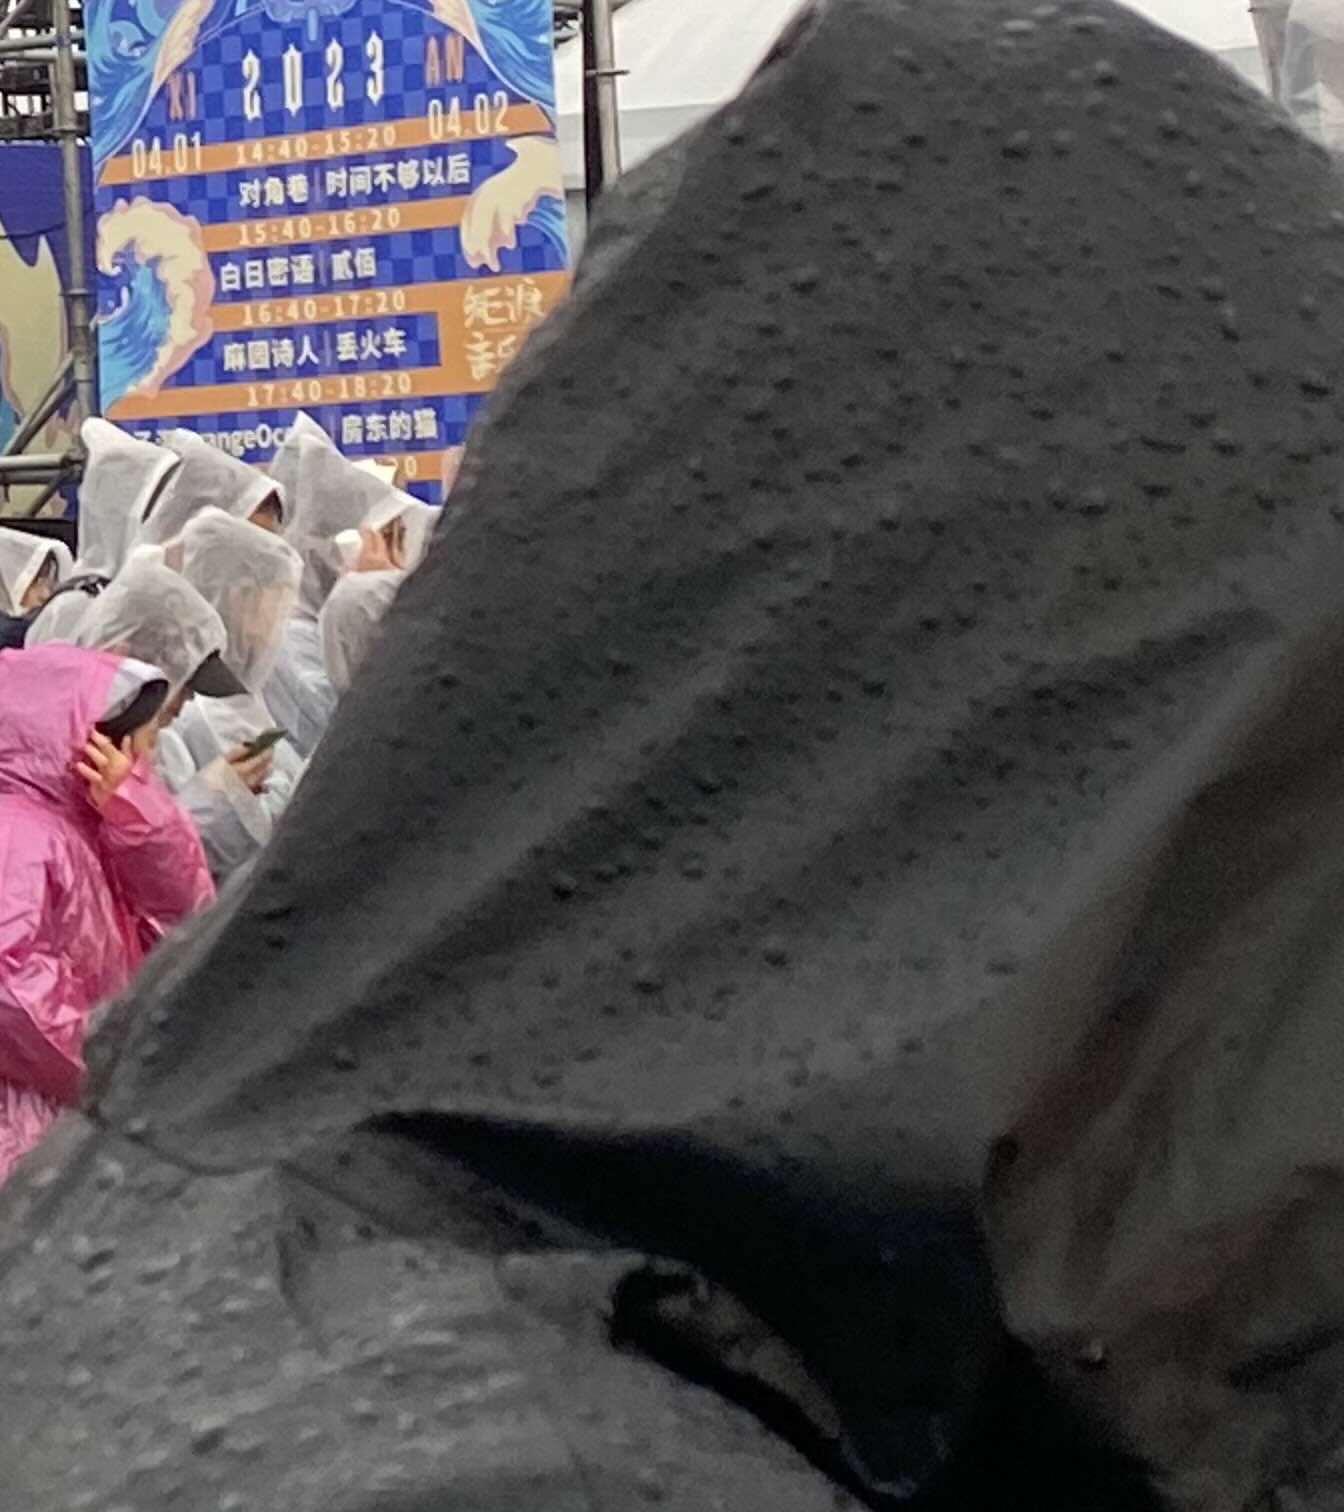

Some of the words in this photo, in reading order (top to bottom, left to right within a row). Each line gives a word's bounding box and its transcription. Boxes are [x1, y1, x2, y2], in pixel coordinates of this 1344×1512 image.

[241, 32, 384, 121] 2023
[424, 34, 465, 86] AN
[132, 132, 202, 178] 04.01
[427, 91, 509, 141] 04.02
[235, 127, 397, 165] 14:40-15:20
[239, 175, 309, 209] 对角巷
[325, 153, 471, 199] 时间不够以后
[238, 208, 401, 245] 15:40-16:20
[219, 255, 315, 292] 白日密语
[330, 247, 377, 282] 贰佰
[242, 290, 407, 326] 16:40-17:20
[222, 335, 320, 372] 麻园诗人
[336, 328, 407, 363] 丢火车
[247, 373, 413, 407] 17:40-18:20
[341, 407, 439, 446] 房东的猫
